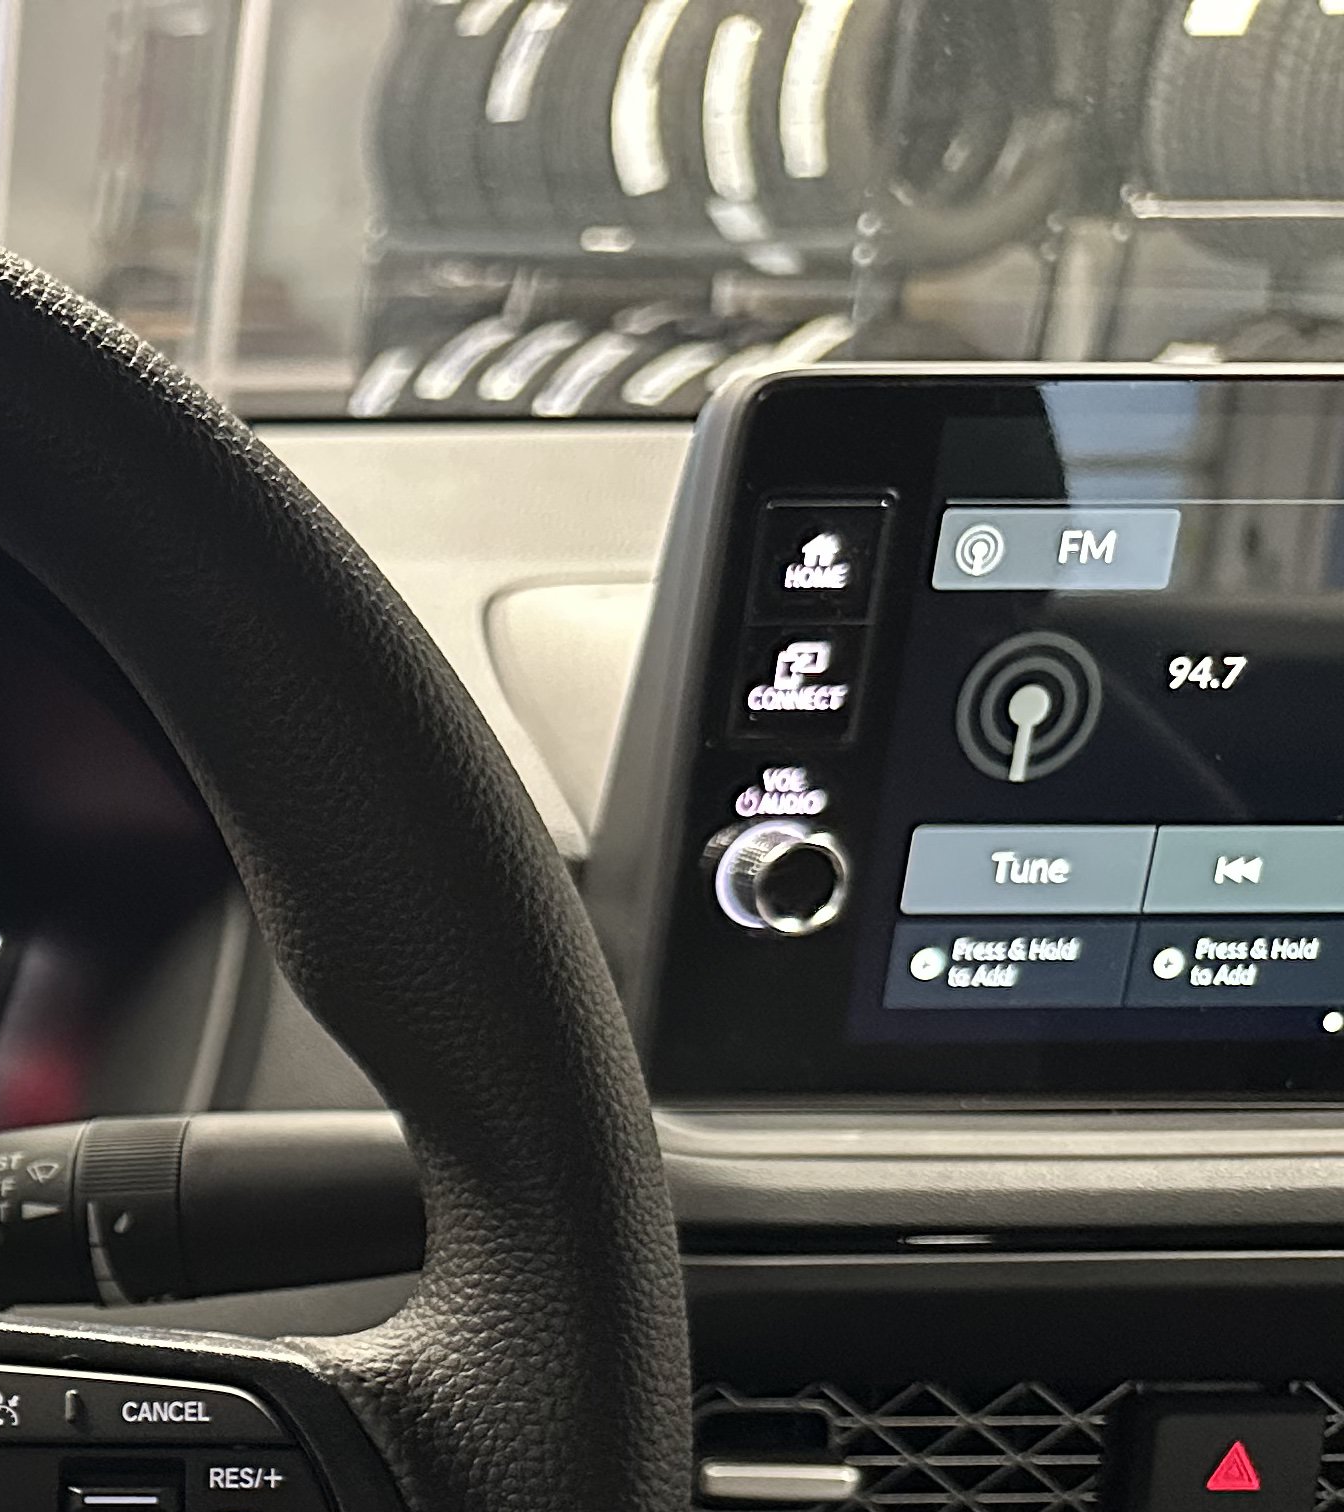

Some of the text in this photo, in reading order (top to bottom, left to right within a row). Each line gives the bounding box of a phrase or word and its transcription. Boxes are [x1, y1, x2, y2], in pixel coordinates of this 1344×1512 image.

[1058, 529, 1117, 565] FM
[785, 563, 848, 588] HOME
[1168, 656, 1247, 691] 94.7
[748, 684, 849, 711] CONNECT
[760, 790, 826, 815] AUDIO
[992, 851, 1071, 885] Tune
[952, 937, 1082, 962] Press & Hold
[1195, 938, 1320, 960] Press & Hold
[948, 965, 1016, 987] to Add
[1190, 964, 1257, 986] to Add
[121, 1400, 212, 1423] CANCEL
[209, 1468, 285, 1489] RES/+
